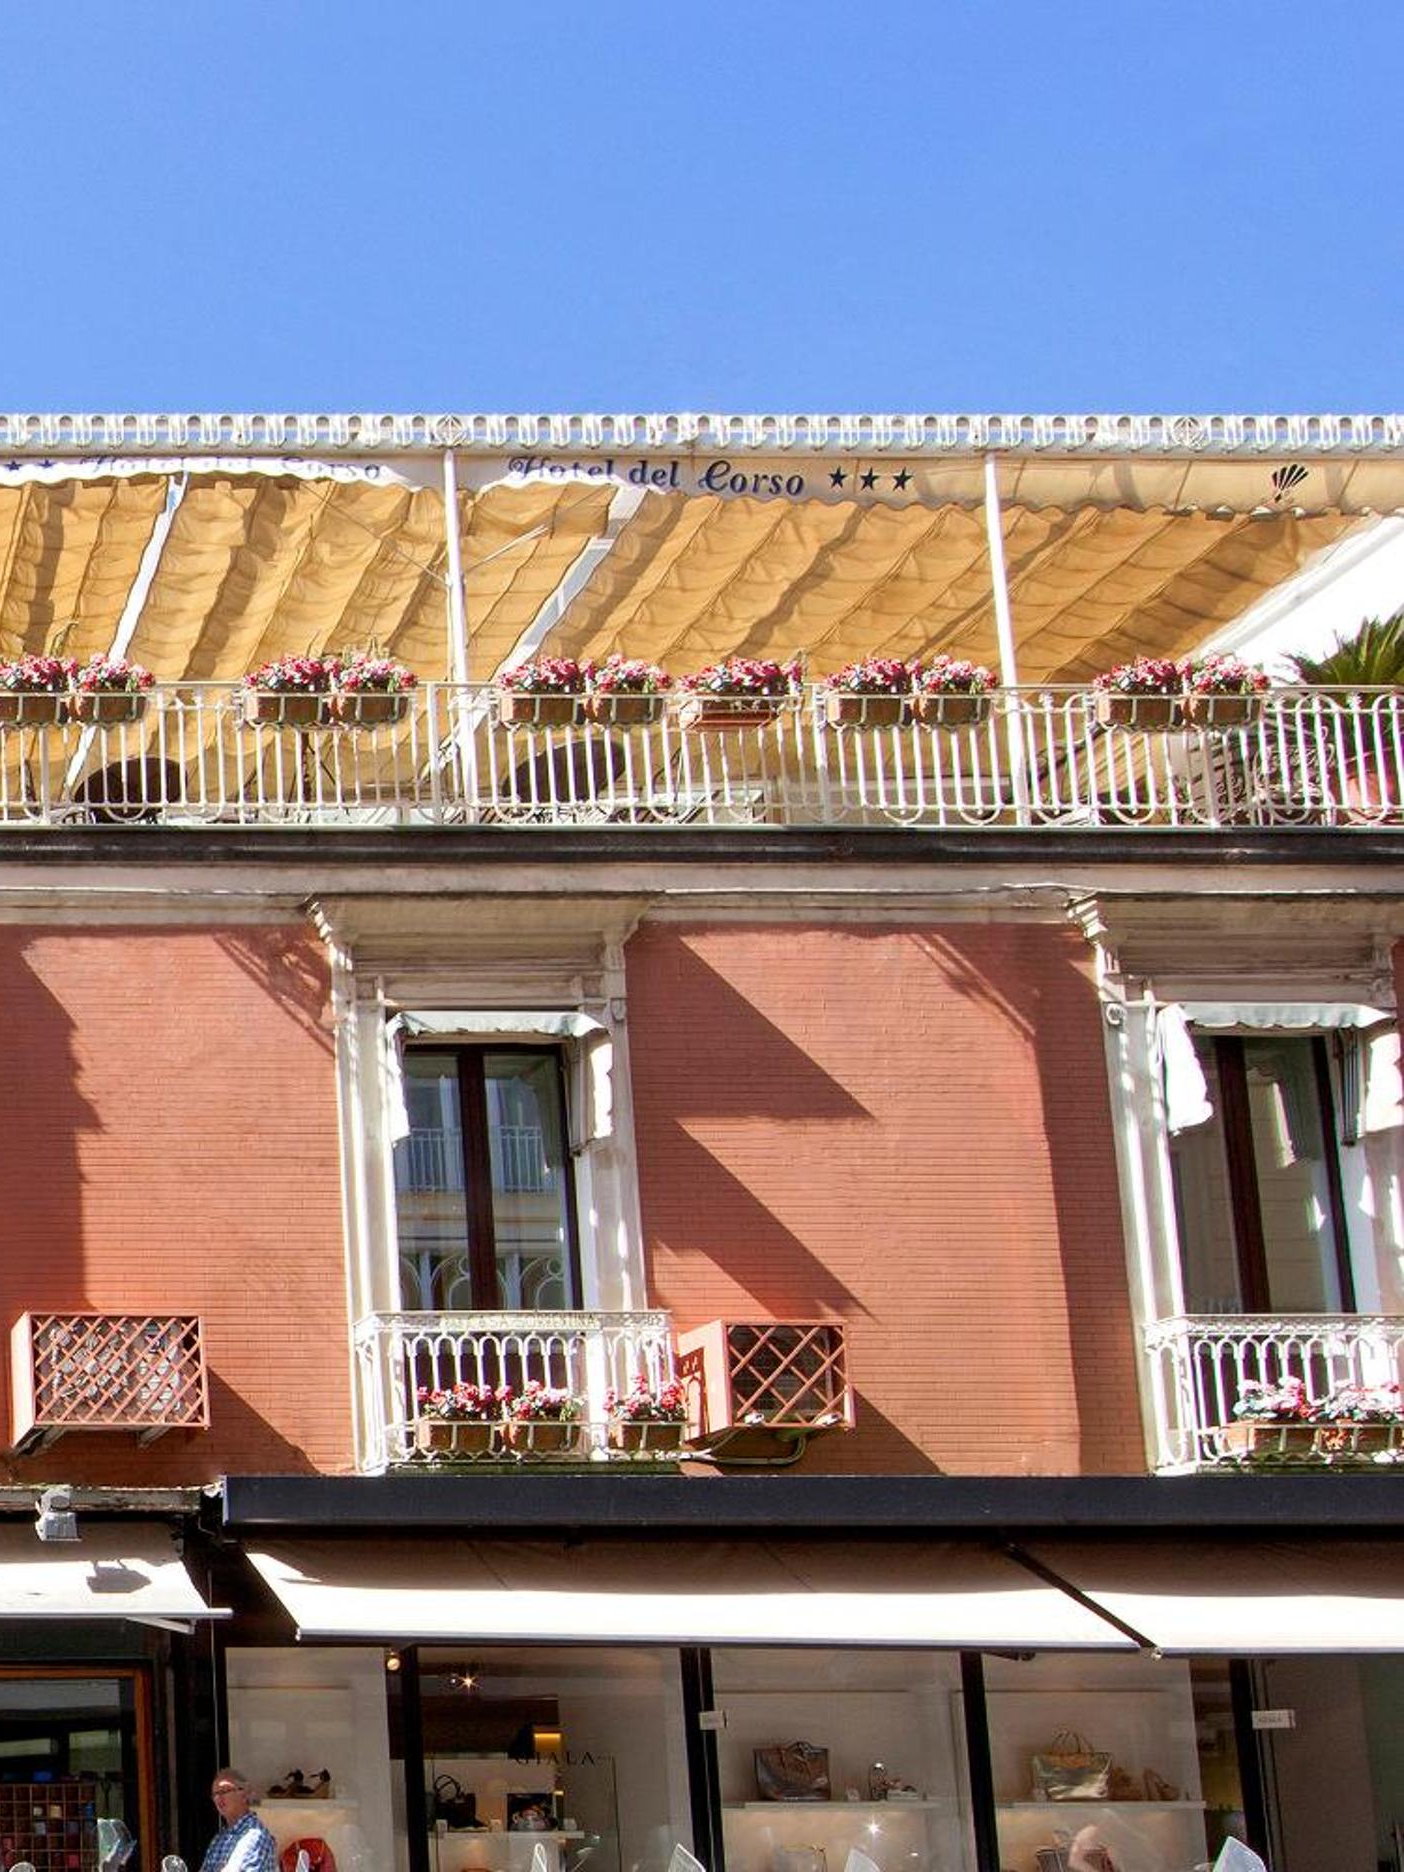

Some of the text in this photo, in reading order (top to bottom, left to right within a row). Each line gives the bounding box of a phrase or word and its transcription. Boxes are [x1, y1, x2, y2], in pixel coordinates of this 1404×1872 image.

[508, 455, 804, 496] Hotel del Corso
